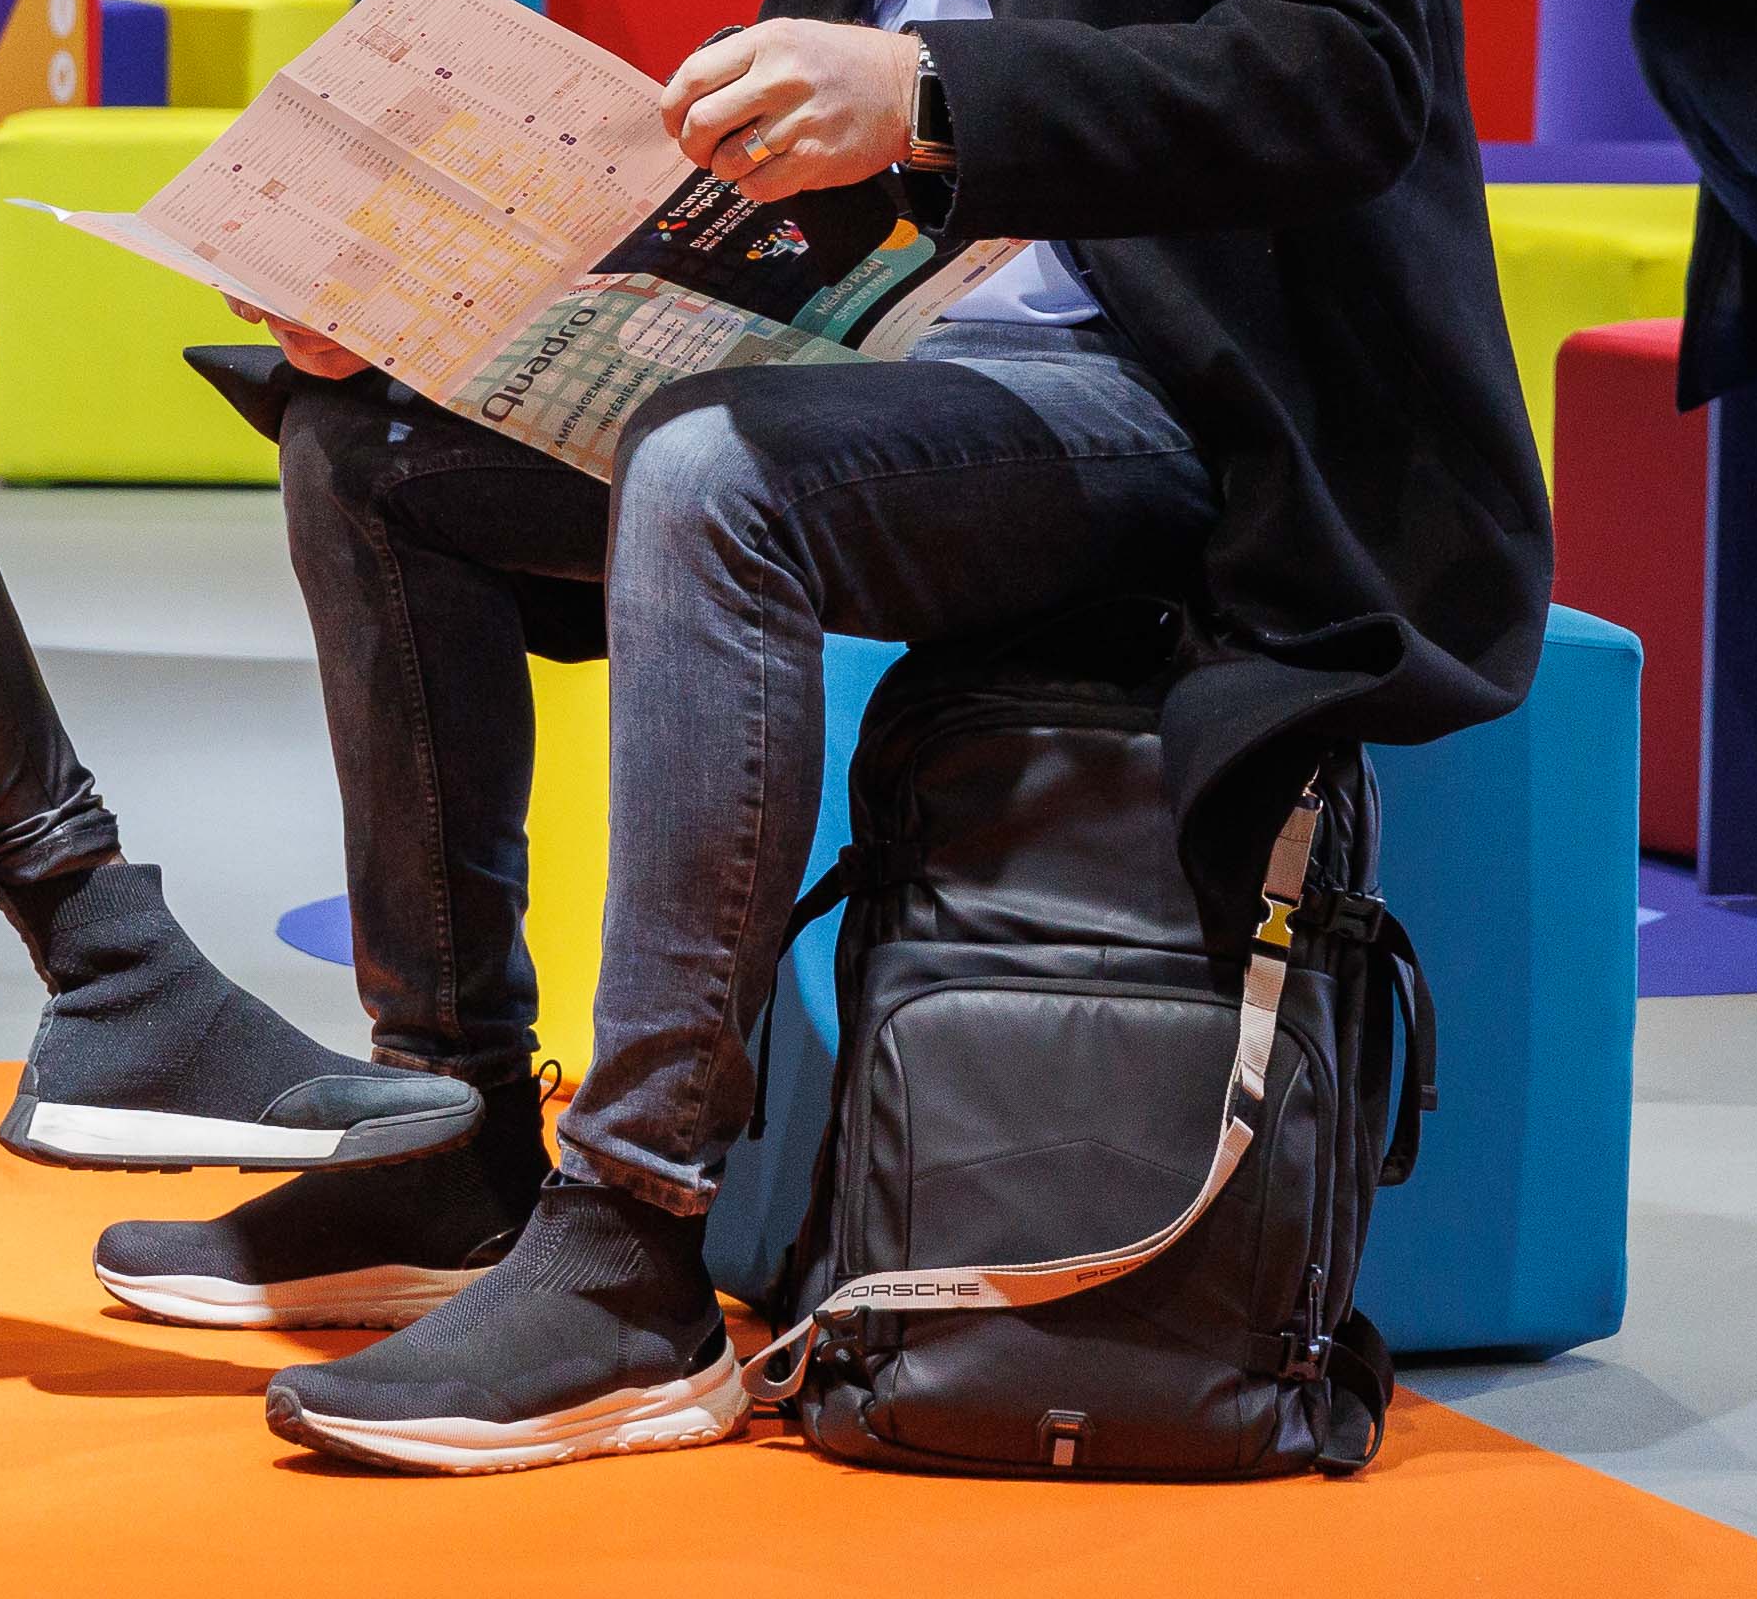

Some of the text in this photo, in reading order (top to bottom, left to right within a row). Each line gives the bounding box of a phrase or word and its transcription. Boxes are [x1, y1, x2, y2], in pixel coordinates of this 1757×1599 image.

[480, 308, 597, 422] quadro
[598, 371, 648, 432] INTÉRIEUR
[555, 363, 619, 449] AMÉNAGEMENT
[834, 1282, 980, 1303] PORSCHE
